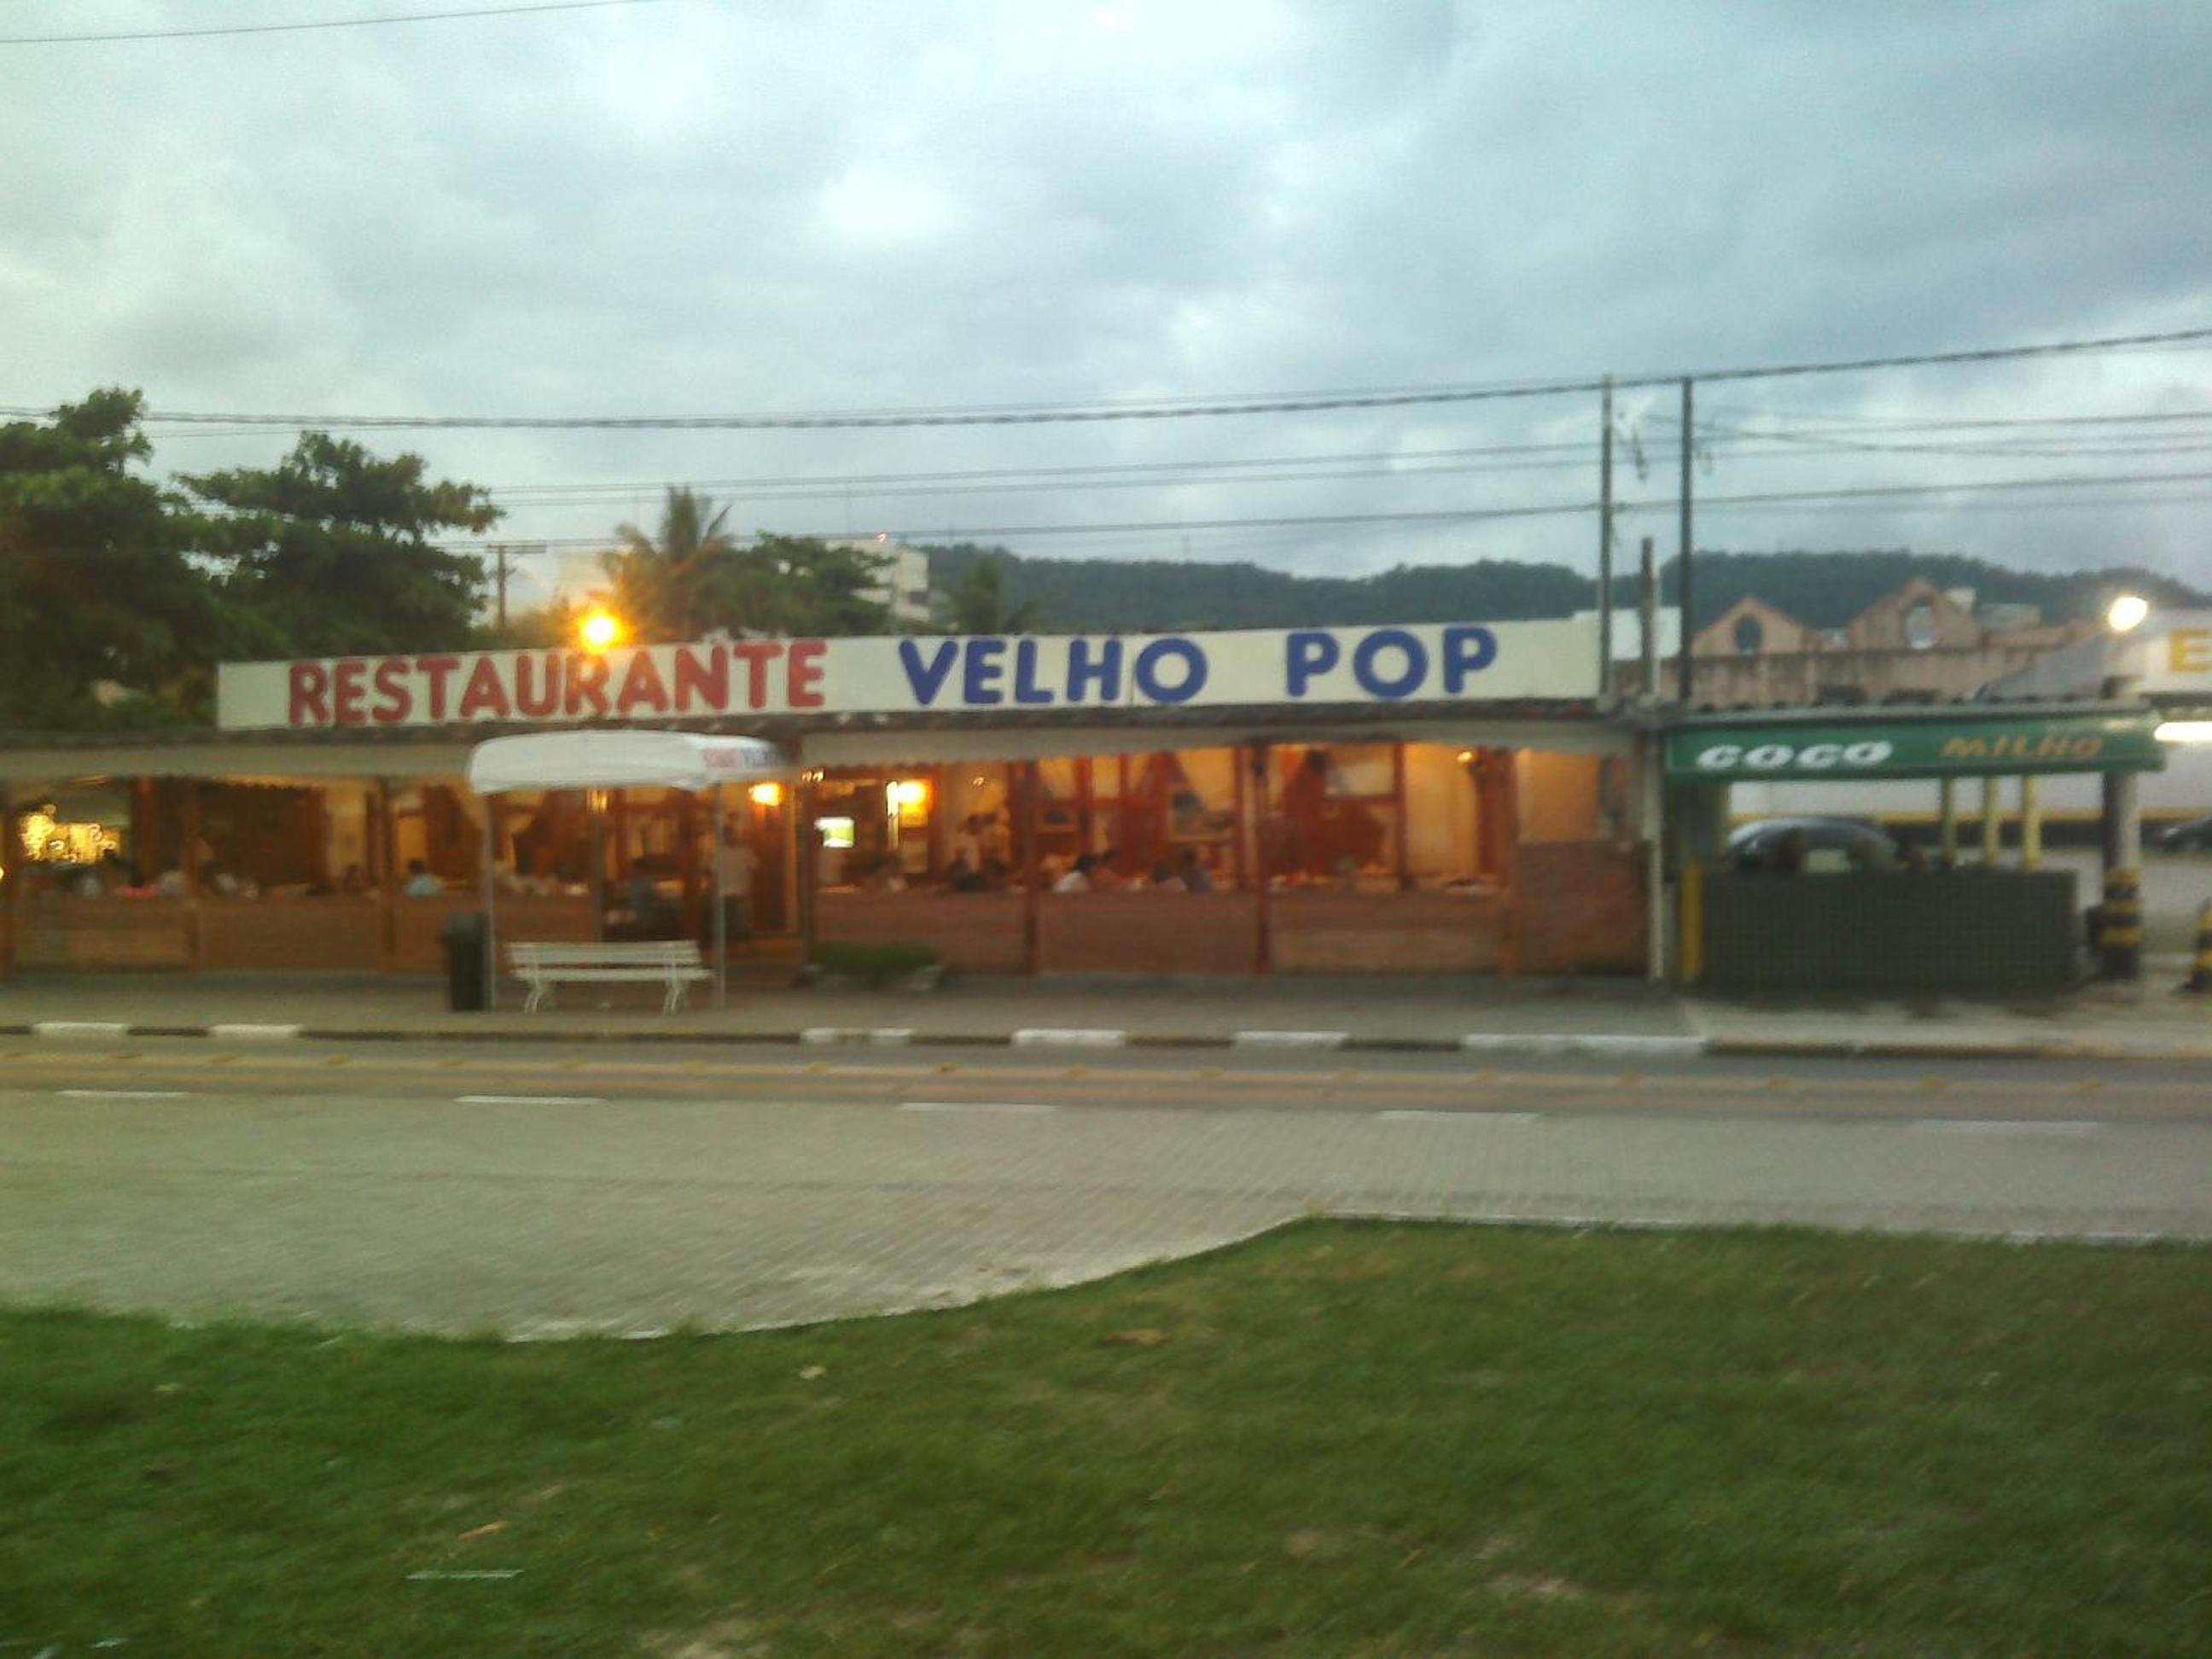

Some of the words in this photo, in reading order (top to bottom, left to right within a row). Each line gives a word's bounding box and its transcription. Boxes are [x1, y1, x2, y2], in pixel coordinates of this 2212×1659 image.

[288, 638, 827, 726] RESTAURANTE
[899, 636, 1208, 704] VELHO
[1286, 626, 1498, 697] POP
[1697, 741, 1894, 769] COCO
[1941, 735, 2104, 759] MILHO
